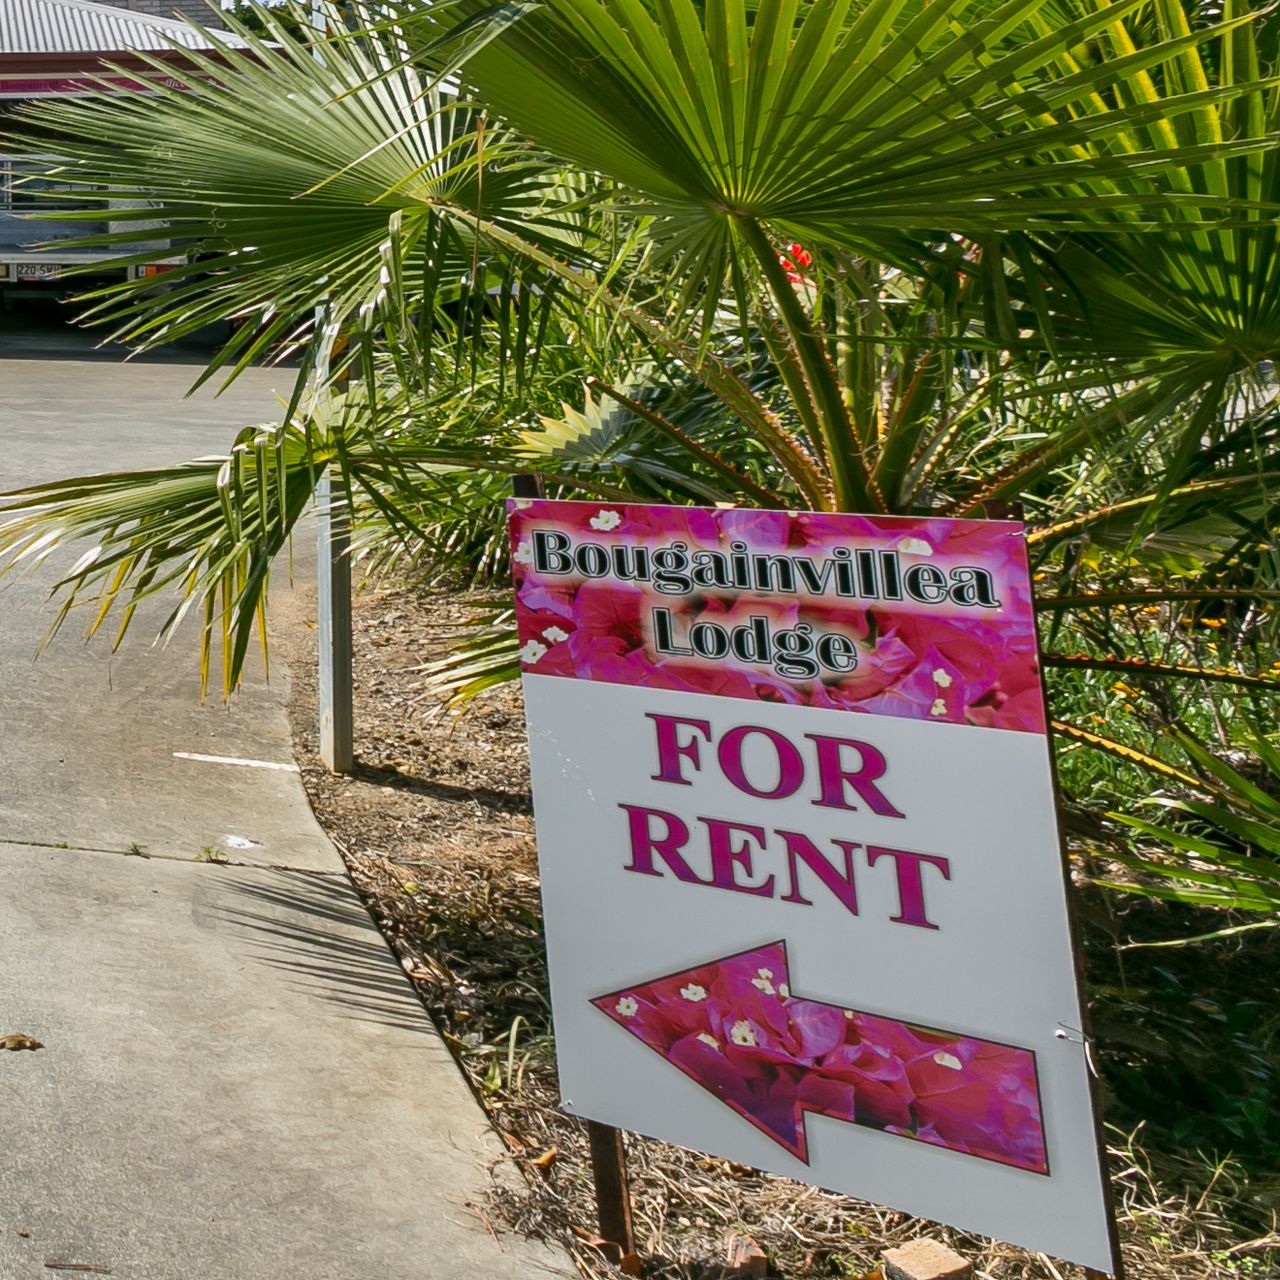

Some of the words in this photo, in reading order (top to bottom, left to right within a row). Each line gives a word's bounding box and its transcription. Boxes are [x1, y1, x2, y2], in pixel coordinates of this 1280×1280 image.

[531, 528, 1003, 609] Bougainvillea
[652, 606, 860, 681] Lodge
[645, 711, 907, 819] FOR
[618, 802, 952, 932] RENT
